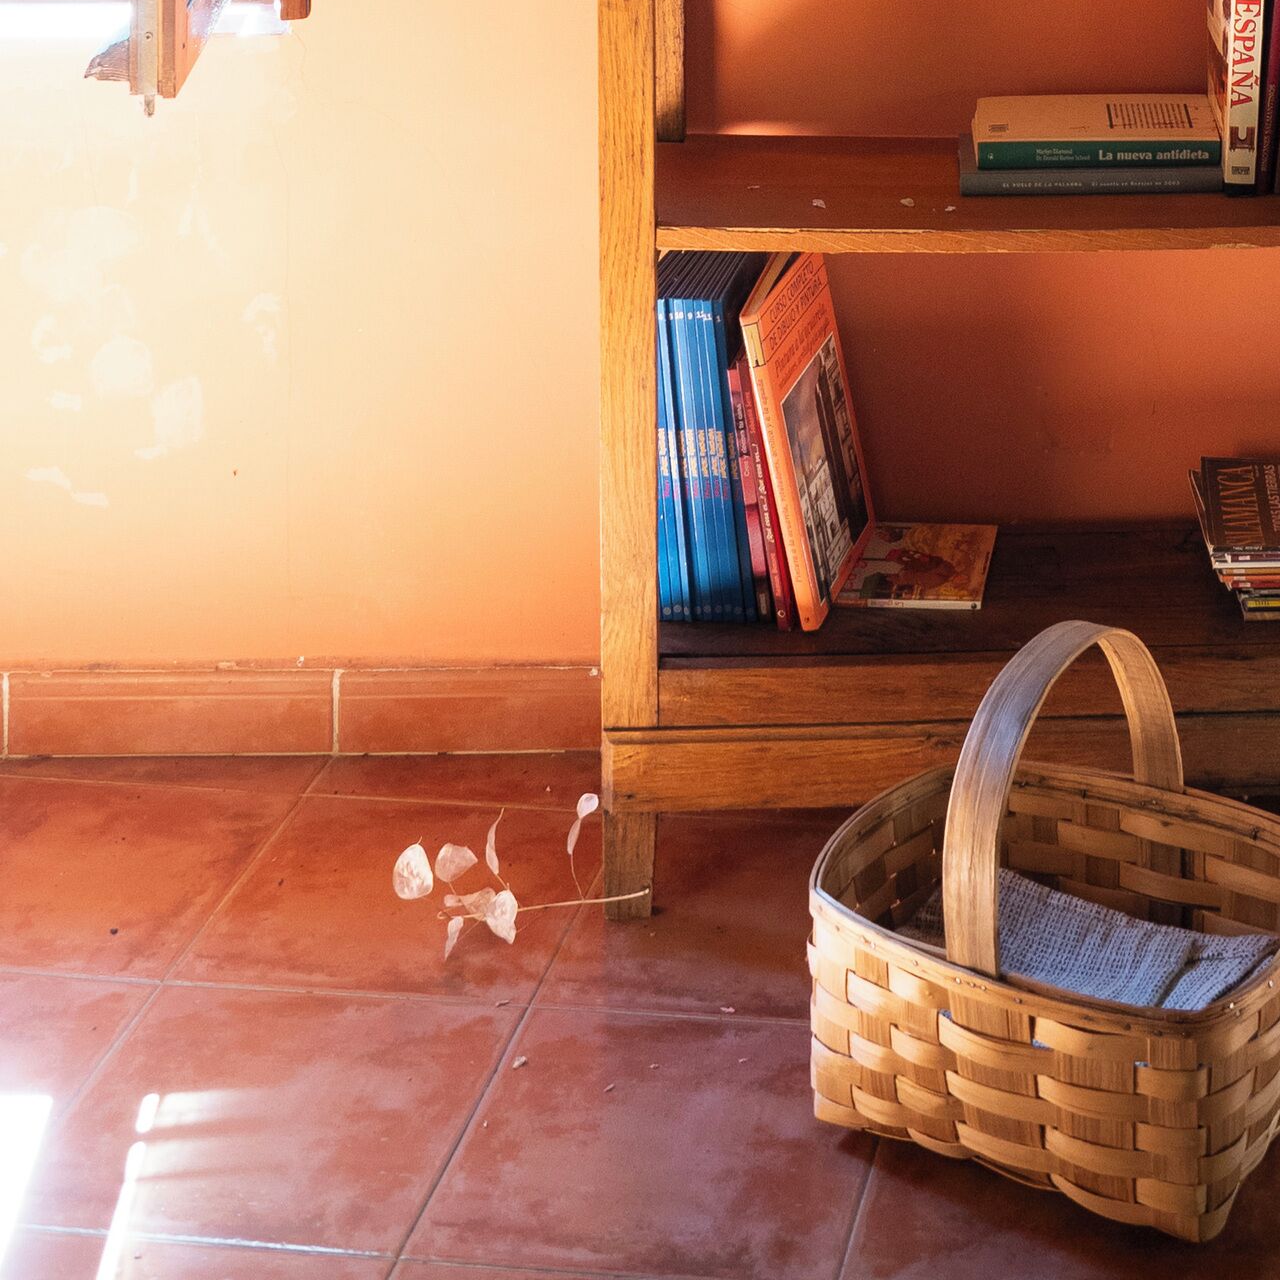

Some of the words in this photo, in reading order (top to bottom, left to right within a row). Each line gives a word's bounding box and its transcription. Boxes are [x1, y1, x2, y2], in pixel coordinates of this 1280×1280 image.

[1098, 149, 1113, 161] La
[1116, 151, 1152, 161] nueva
[1155, 148, 1210, 160] antidieta
[769, 294, 791, 323] CURSO
[787, 260, 814, 303] COMPLETO
[770, 334, 781, 351] DE
[780, 313, 796, 340] DIBUJO
[798, 276, 822, 314] PINTURA
[1263, 464, 1279, 495] TIERRAS
